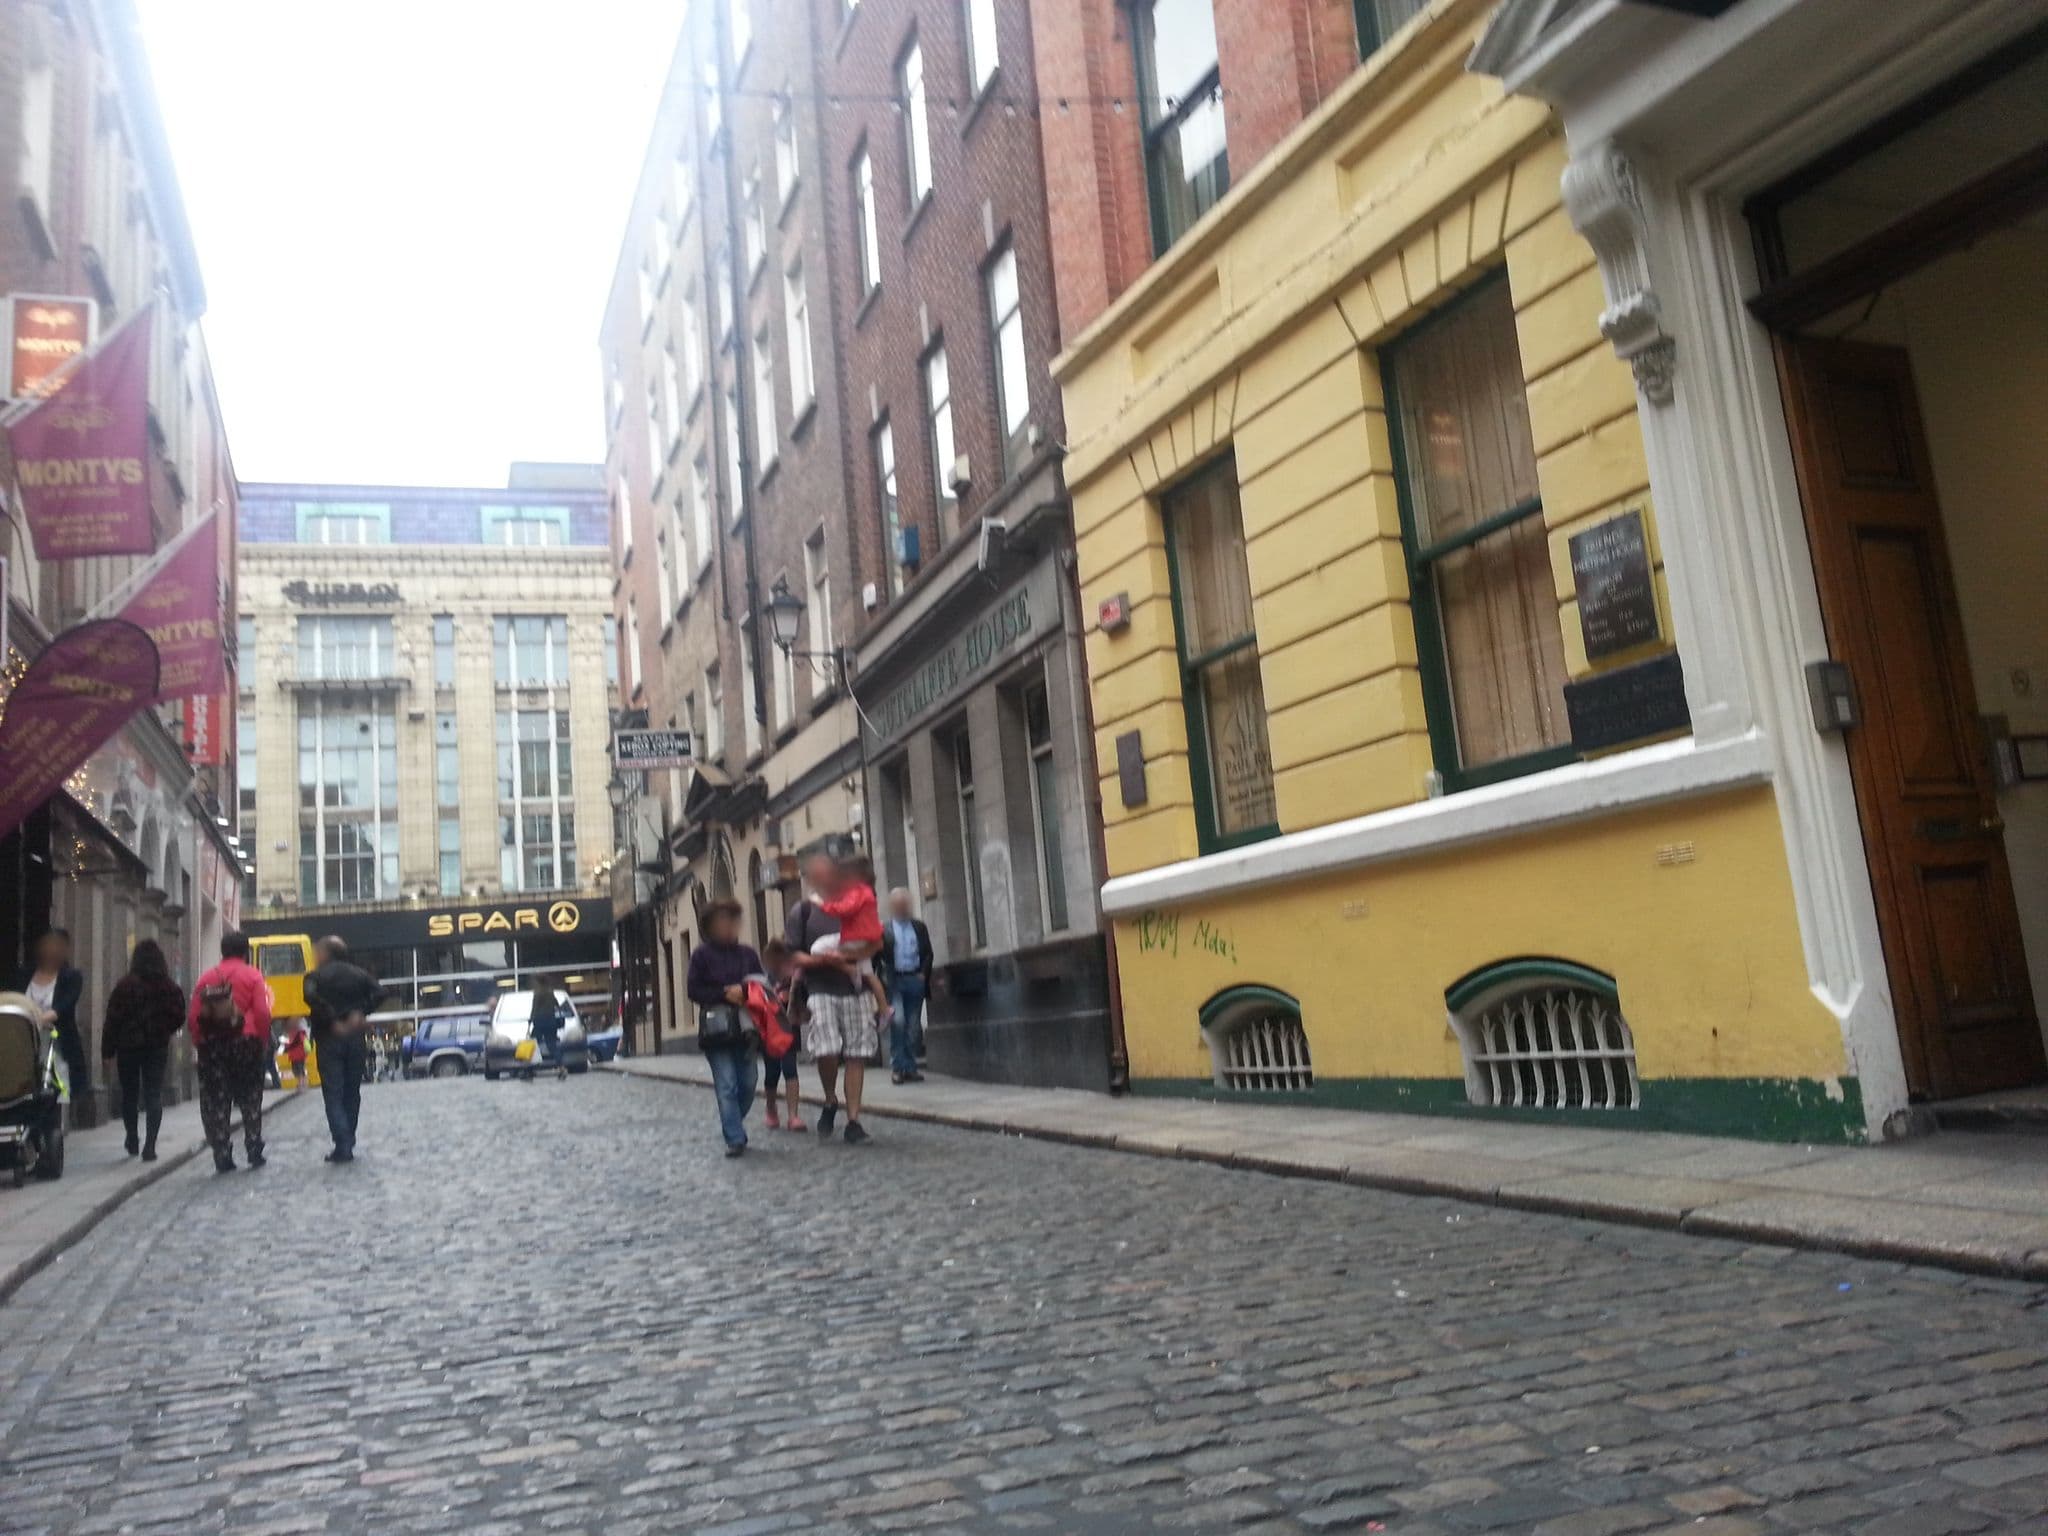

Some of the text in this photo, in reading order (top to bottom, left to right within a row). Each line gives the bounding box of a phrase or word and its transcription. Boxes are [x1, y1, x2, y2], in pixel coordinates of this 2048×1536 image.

[17, 458, 144, 487] MONTYS
[145, 618, 217, 643] ONTYS
[965, 587, 1032, 675] HOUSE
[429, 908, 539, 937] SPAR
